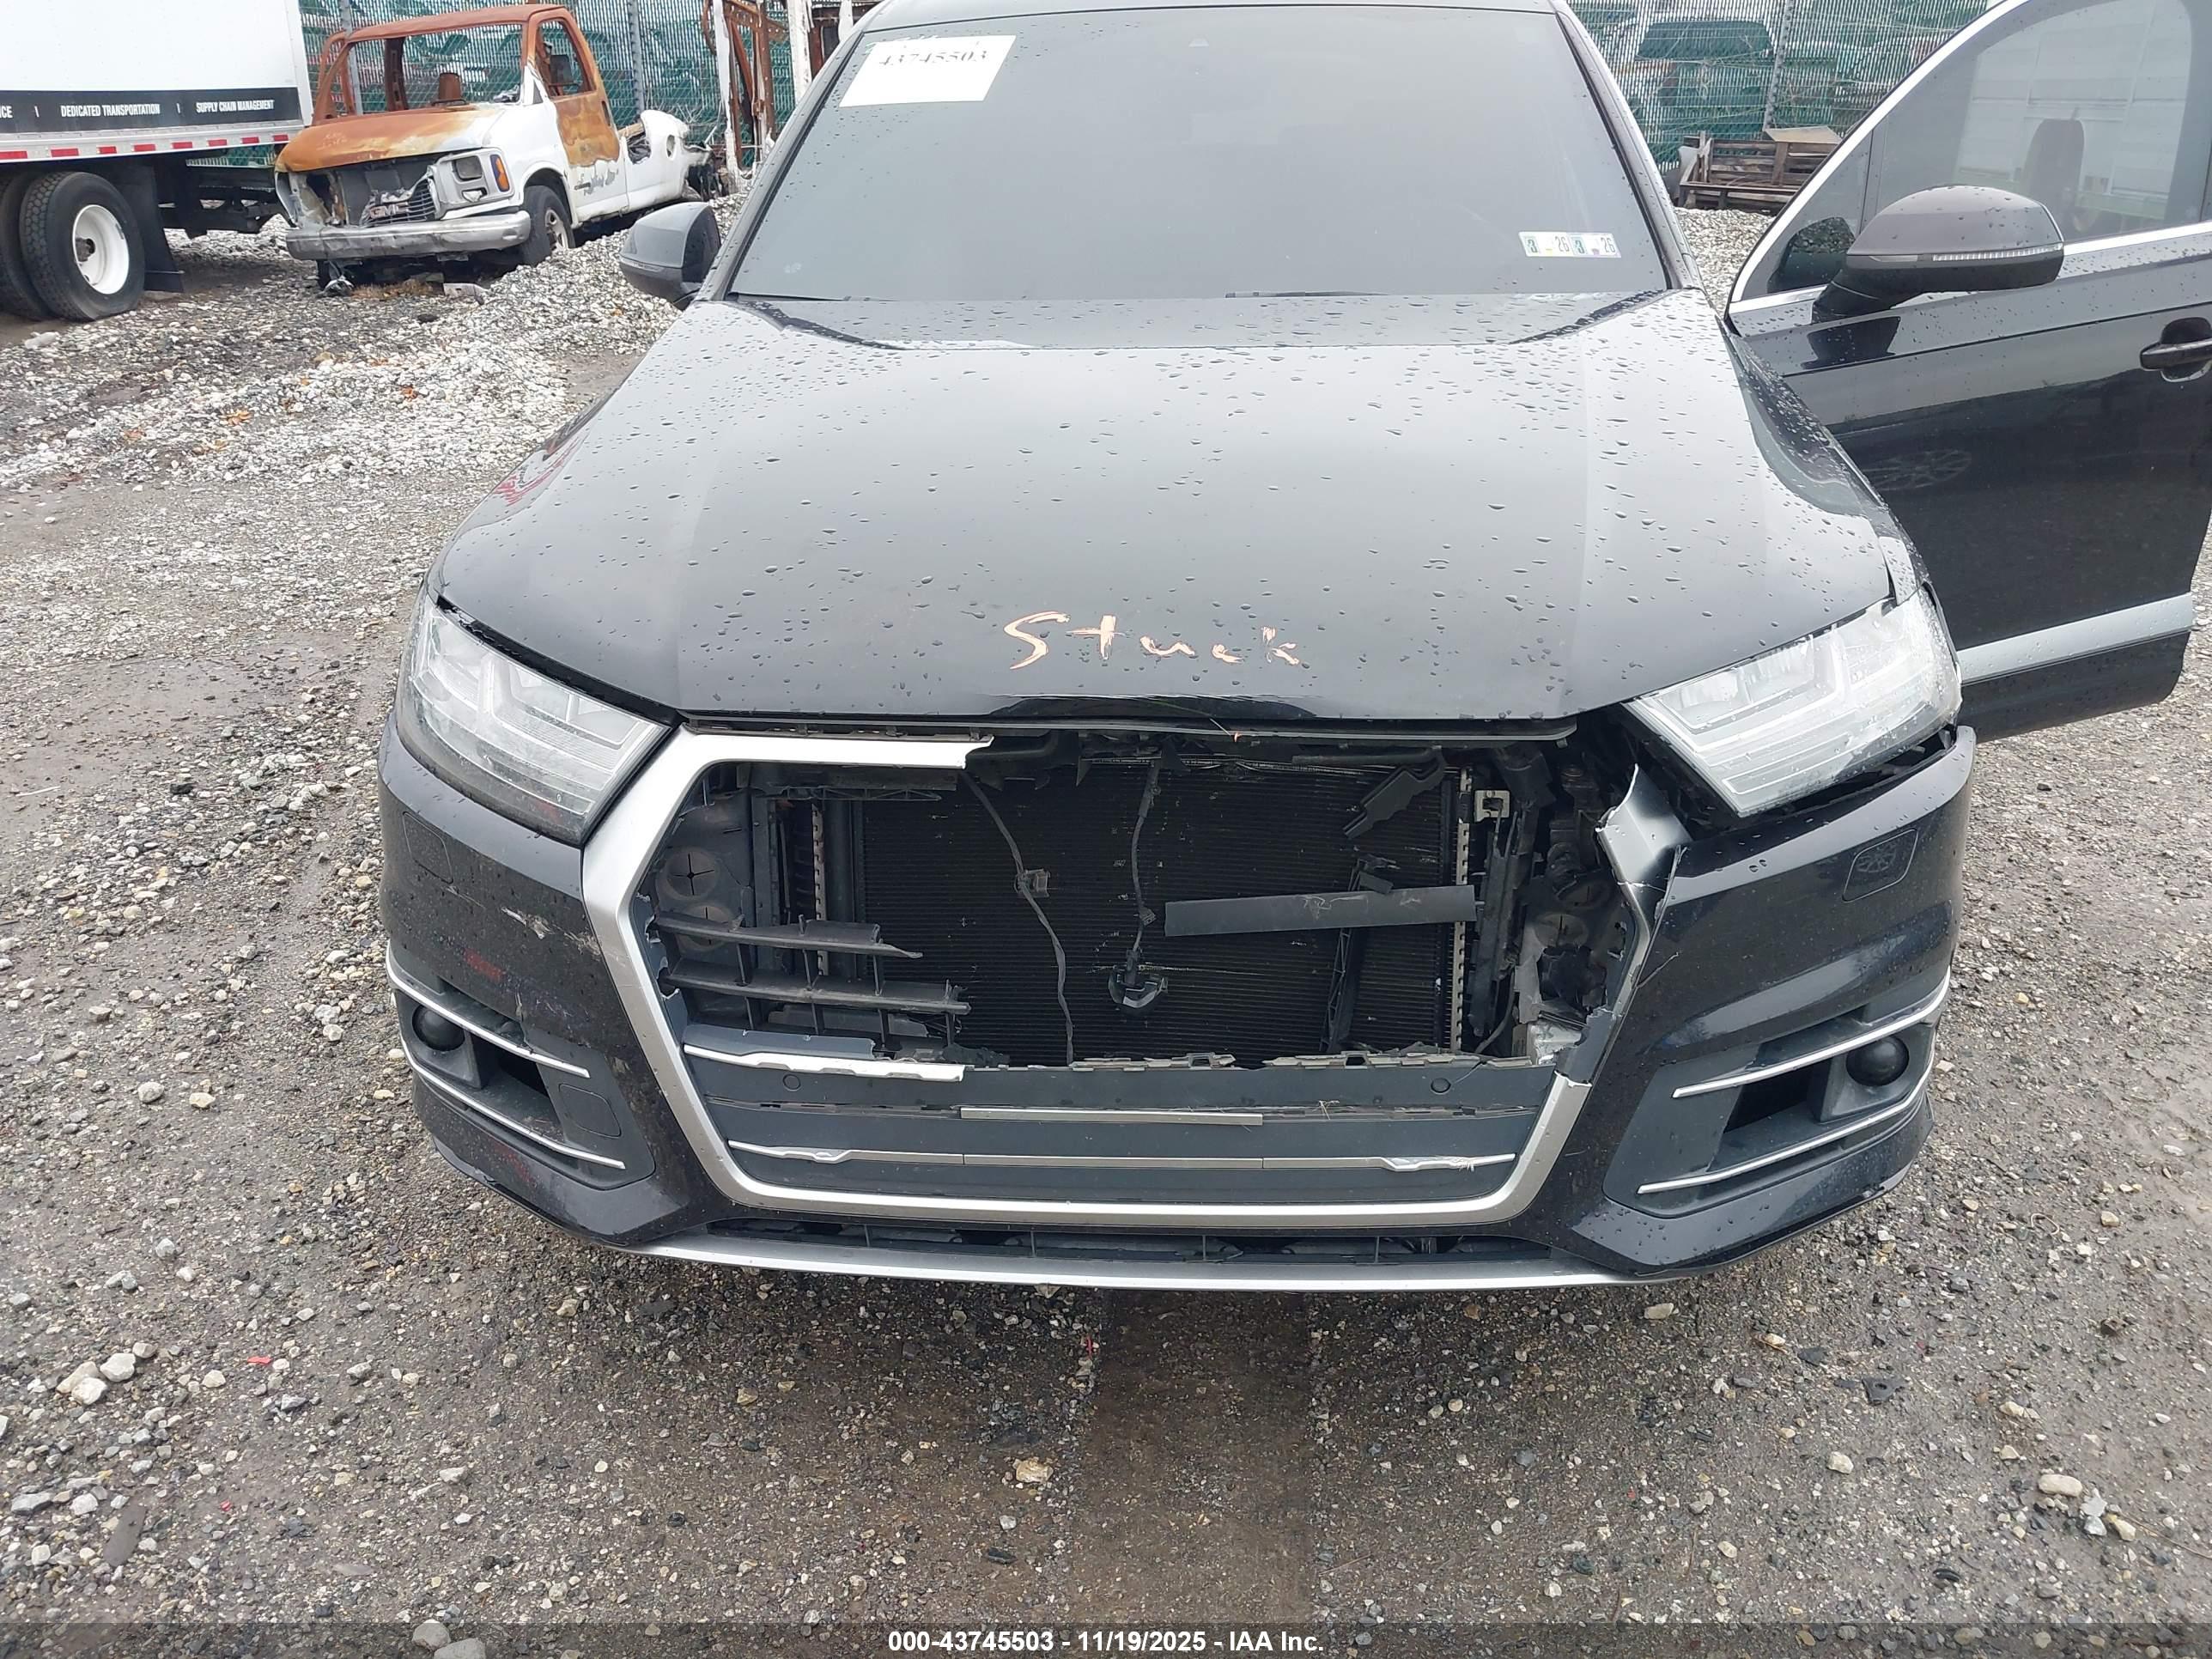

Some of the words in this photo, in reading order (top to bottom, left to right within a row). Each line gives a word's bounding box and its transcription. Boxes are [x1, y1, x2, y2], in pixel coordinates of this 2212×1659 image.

[60, 105, 101, 118] DEDICATED
[102, 103, 161, 117] TRANSPORTATION
[196, 101, 219, 113] SUPPLY
[219, 100, 237, 112] CHAIN
[236, 99, 275, 112] MANAGEMENT
[370, 201, 409, 219] GMC
[1528, 239, 1539, 253] 3
[1555, 235, 1570, 252] 26
[1575, 240, 1585, 254] 3
[1601, 236, 1616, 253] 26
[1003, 611, 1300, 670] Stuck
